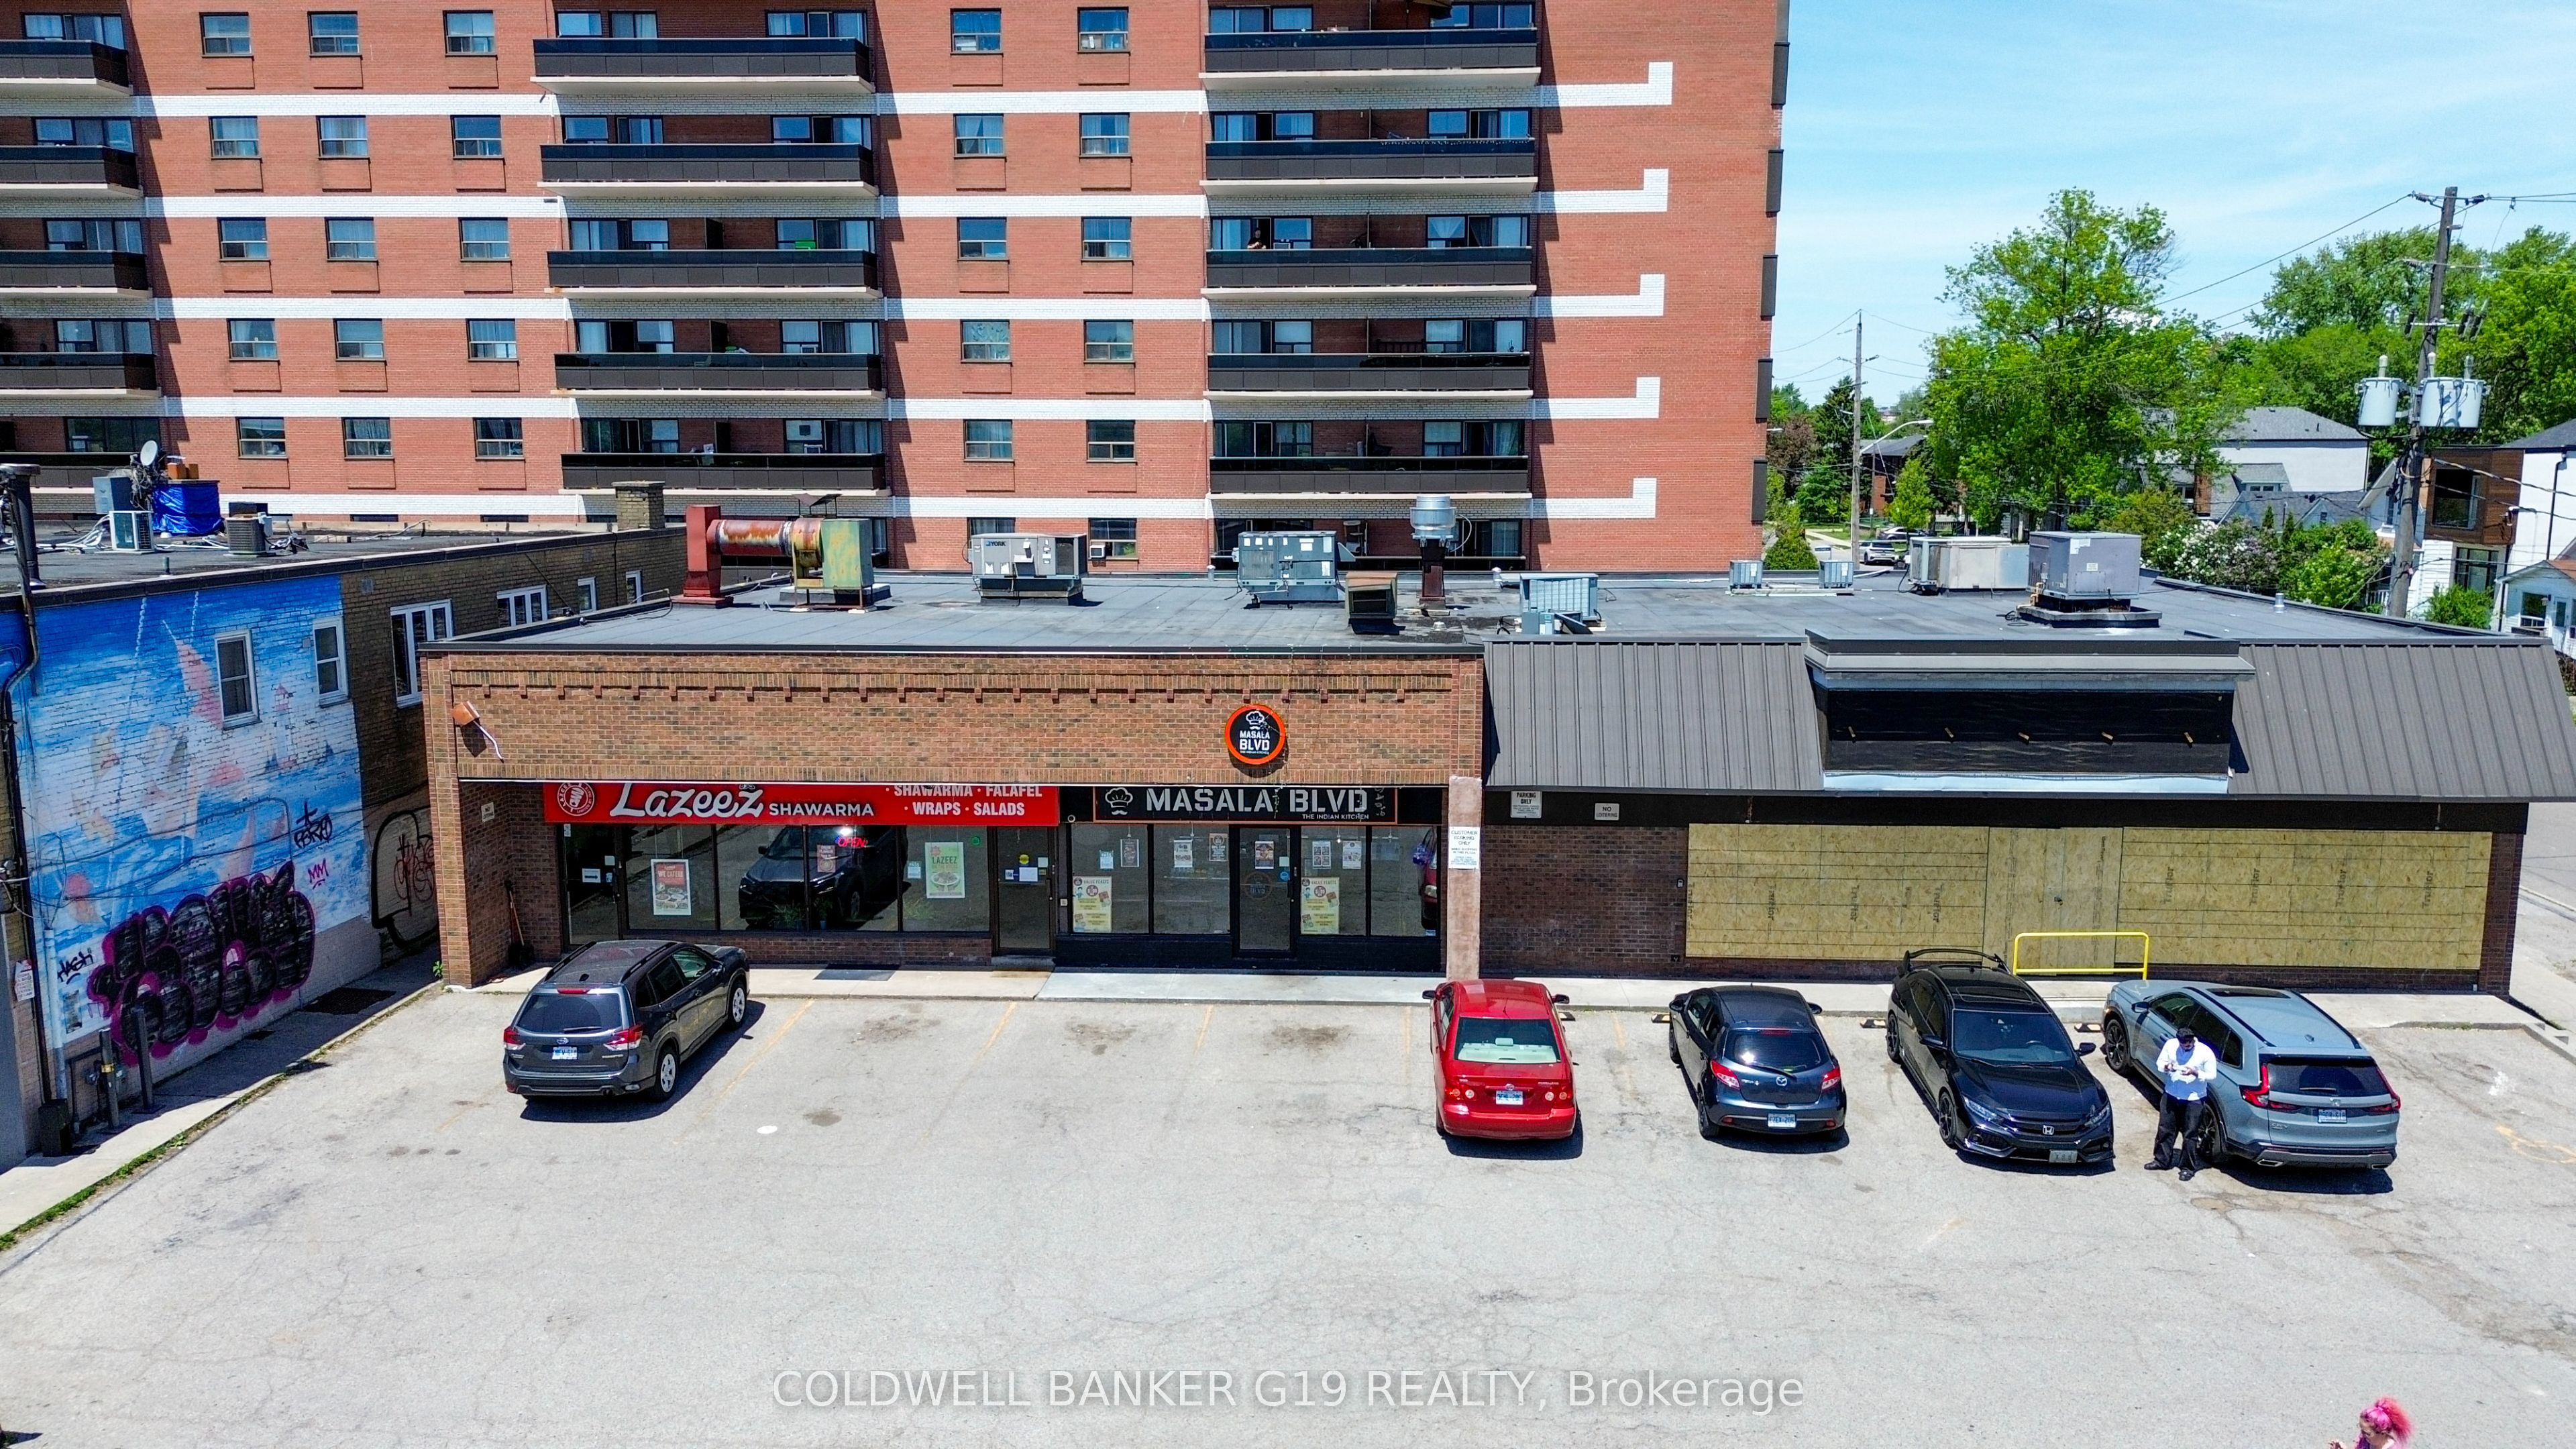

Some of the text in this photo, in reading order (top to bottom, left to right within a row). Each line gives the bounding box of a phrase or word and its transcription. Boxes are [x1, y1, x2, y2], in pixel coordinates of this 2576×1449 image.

[1239, 730, 1271, 739] MASALA
[1239, 739, 1271, 751] BLVD
[894, 785, 1042, 798] SHAWARMA FALAFEL
[1146, 788, 1368, 813] MASALA BLVD
[769, 802, 875, 817] SHAWARMA
[913, 802, 1025, 816] WRAPS SALADS
[838, 837, 866, 848] OPEN
[932, 856, 957, 864] LAZEEZ
